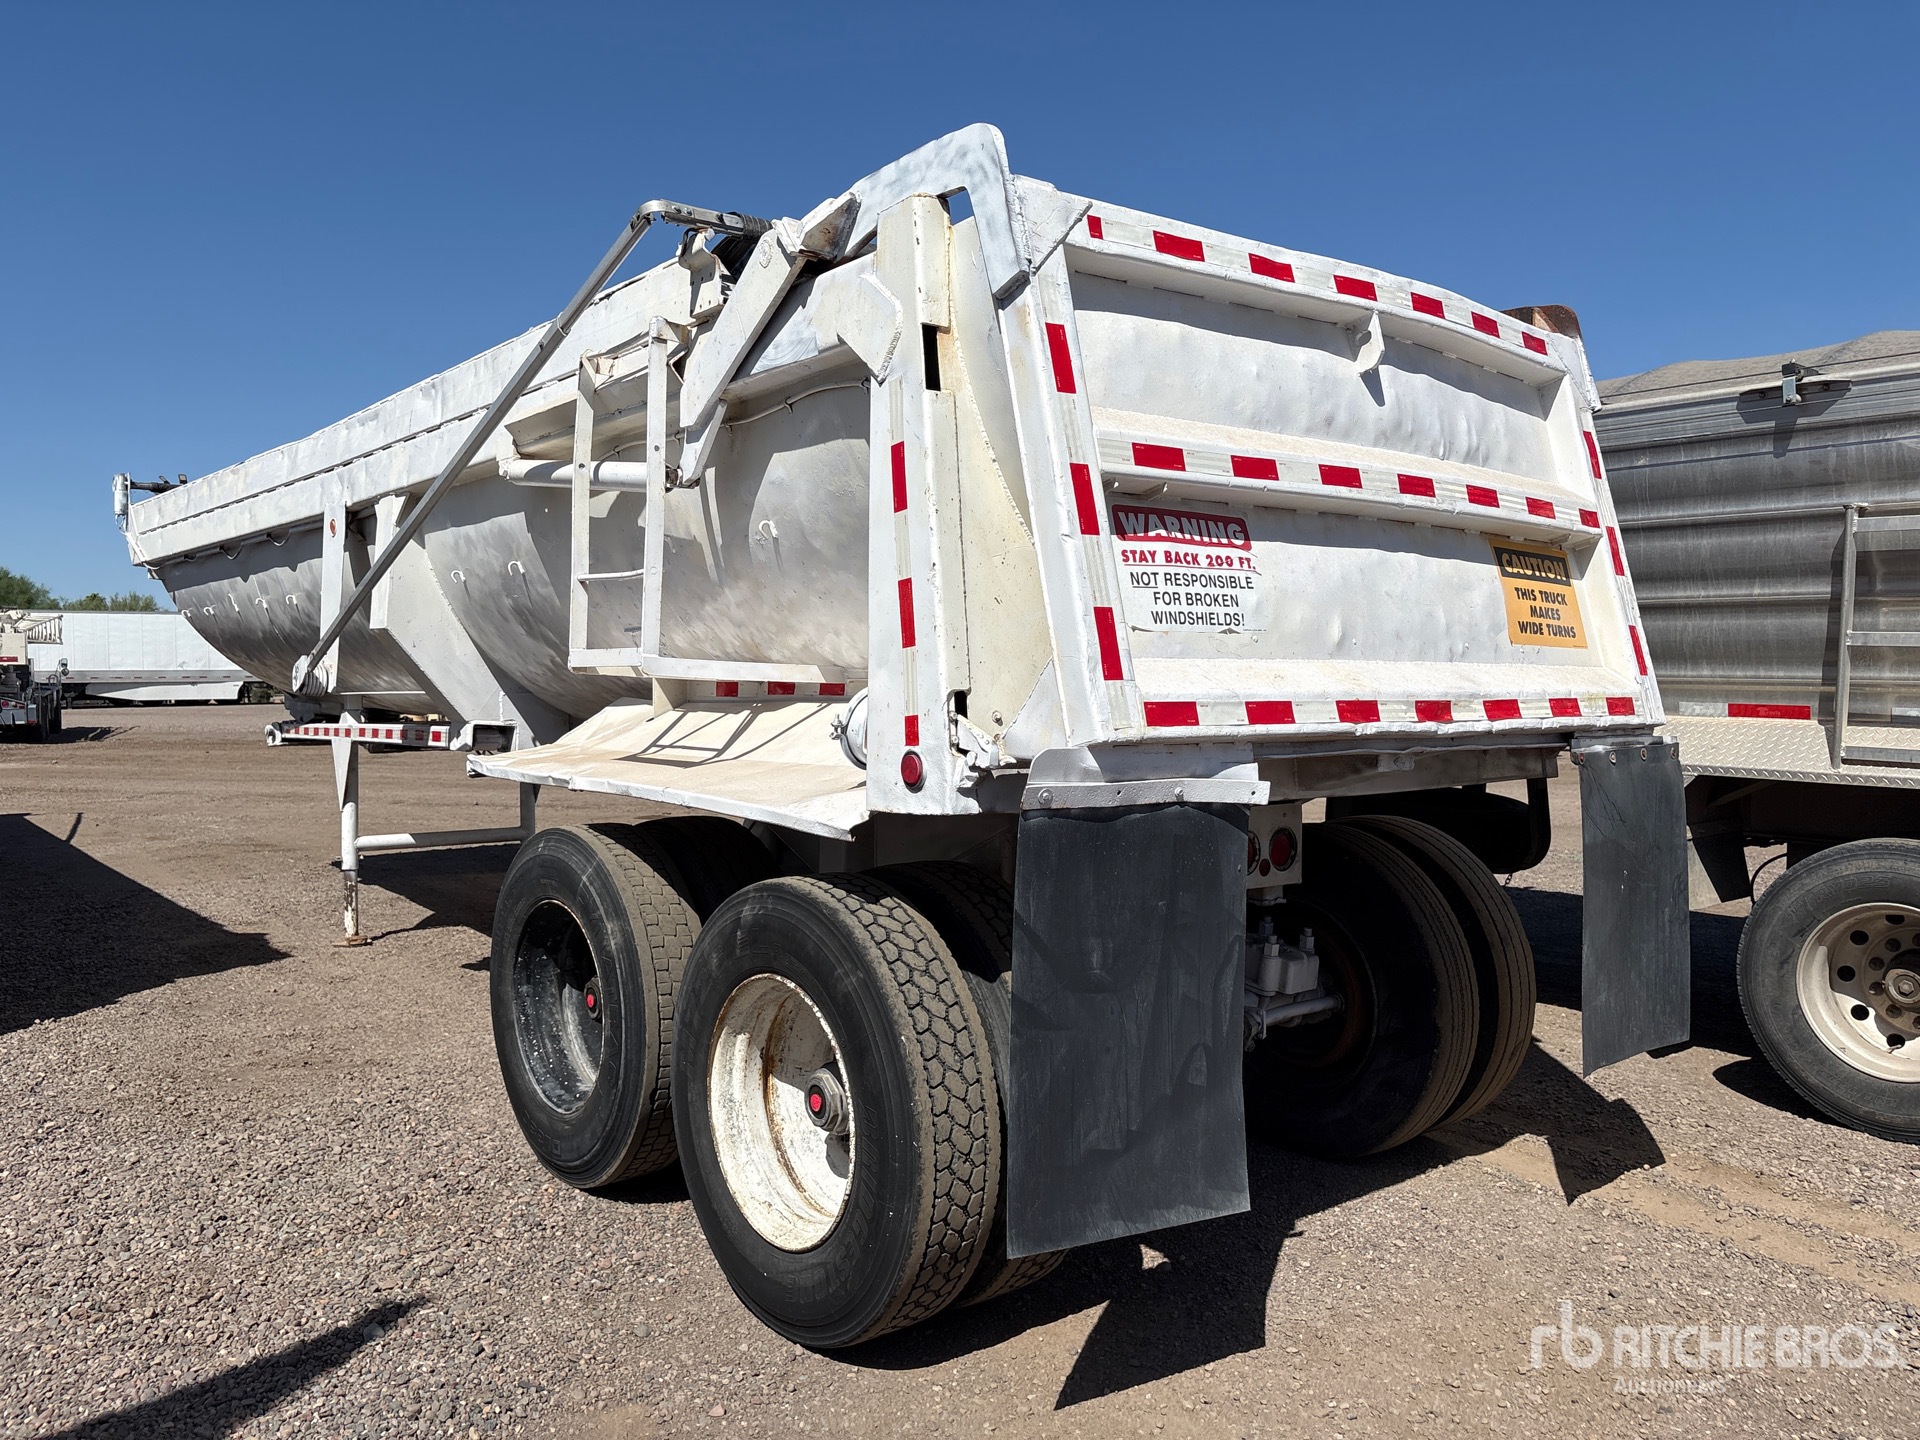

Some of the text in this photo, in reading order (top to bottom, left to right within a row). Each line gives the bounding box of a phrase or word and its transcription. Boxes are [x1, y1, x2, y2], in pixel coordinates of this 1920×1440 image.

[1117, 511, 1246, 546] WARNING
[1121, 549, 1257, 570] STAY BACK 200 FT.
[1501, 552, 1567, 581] CAUTION
[1130, 571, 1255, 590] NOT RESPONSIBLE
[1153, 591, 1240, 608] FOR BROKEN
[1514, 586, 1568, 606] THIS TRUCK
[1150, 610, 1246, 627] WINDSHIELDS!
[1529, 604, 1561, 621] MAKES
[1517, 620, 1577, 639] WIDE TURNS
